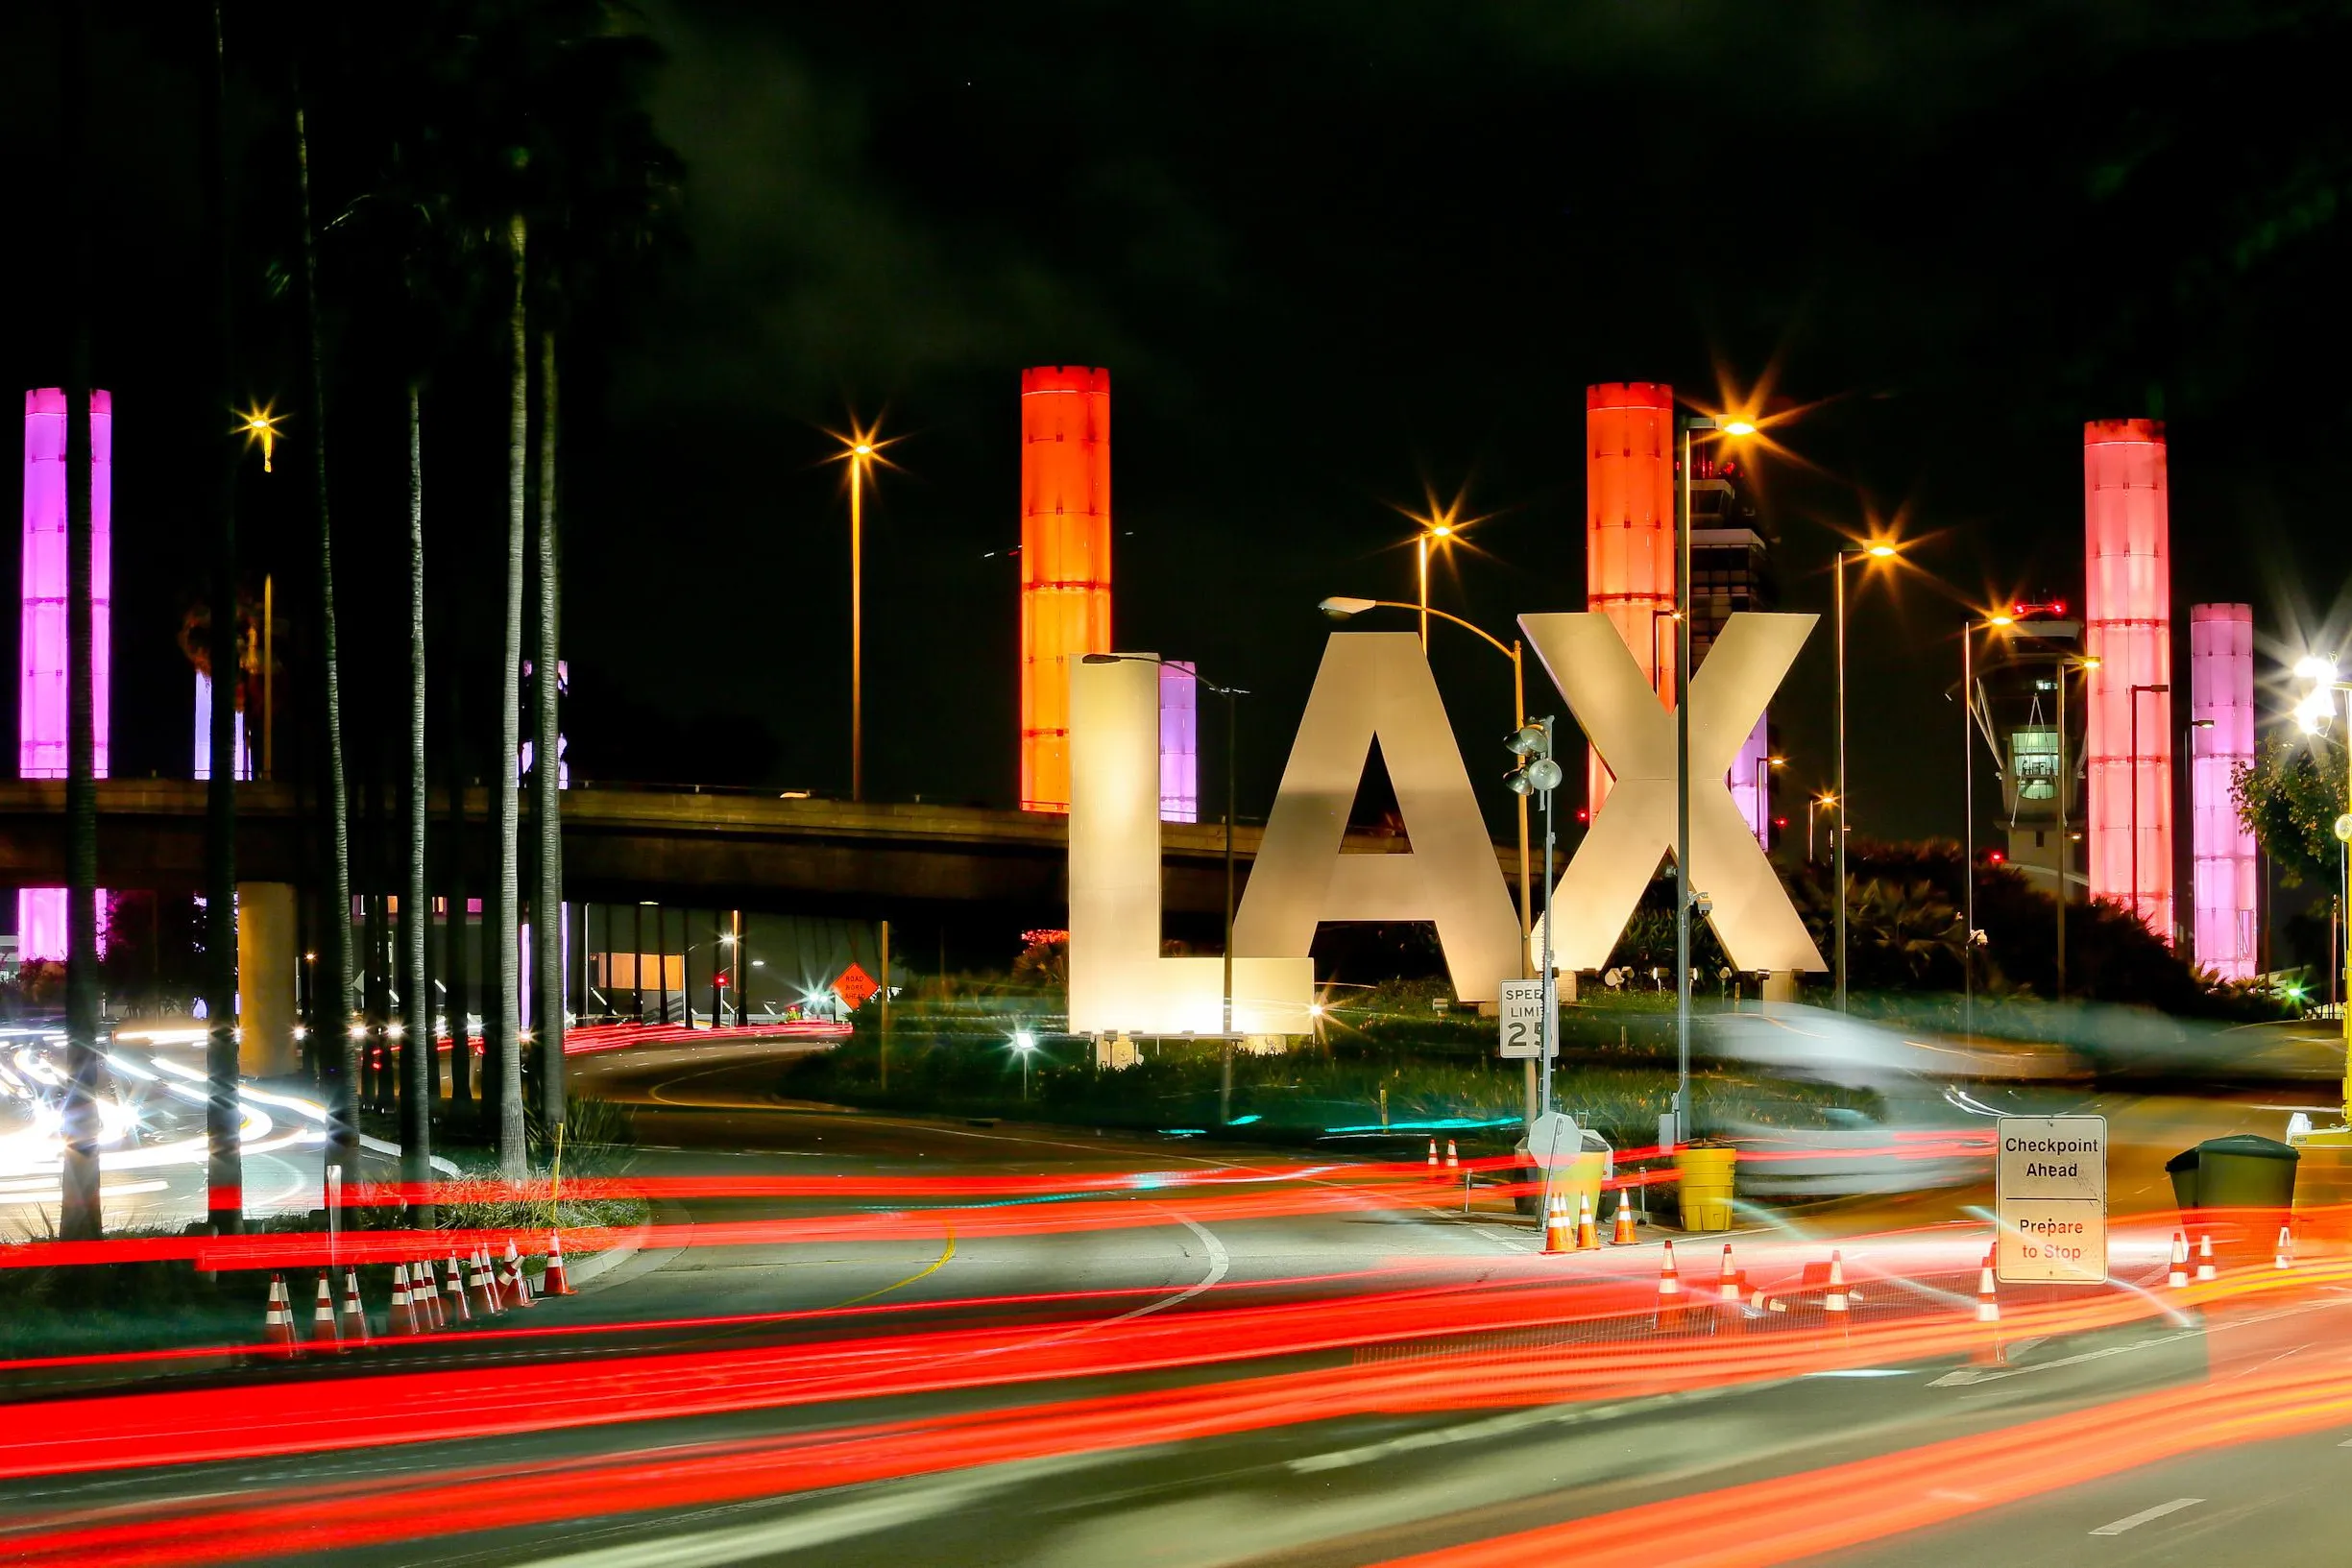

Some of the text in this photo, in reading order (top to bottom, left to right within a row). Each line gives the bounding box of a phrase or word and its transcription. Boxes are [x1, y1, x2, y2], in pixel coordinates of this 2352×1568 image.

[1069, 613, 1829, 1035] LAX
[1506, 989, 1543, 1001] SPEE
[1511, 1006, 1544, 1018] LIMI
[2005, 1138, 2098, 1156] Checkpoint
[2025, 1163, 2077, 1177] Ahead
[2020, 1218, 2083, 1237] Prepare
[2023, 1244, 2081, 1262] to Stop
